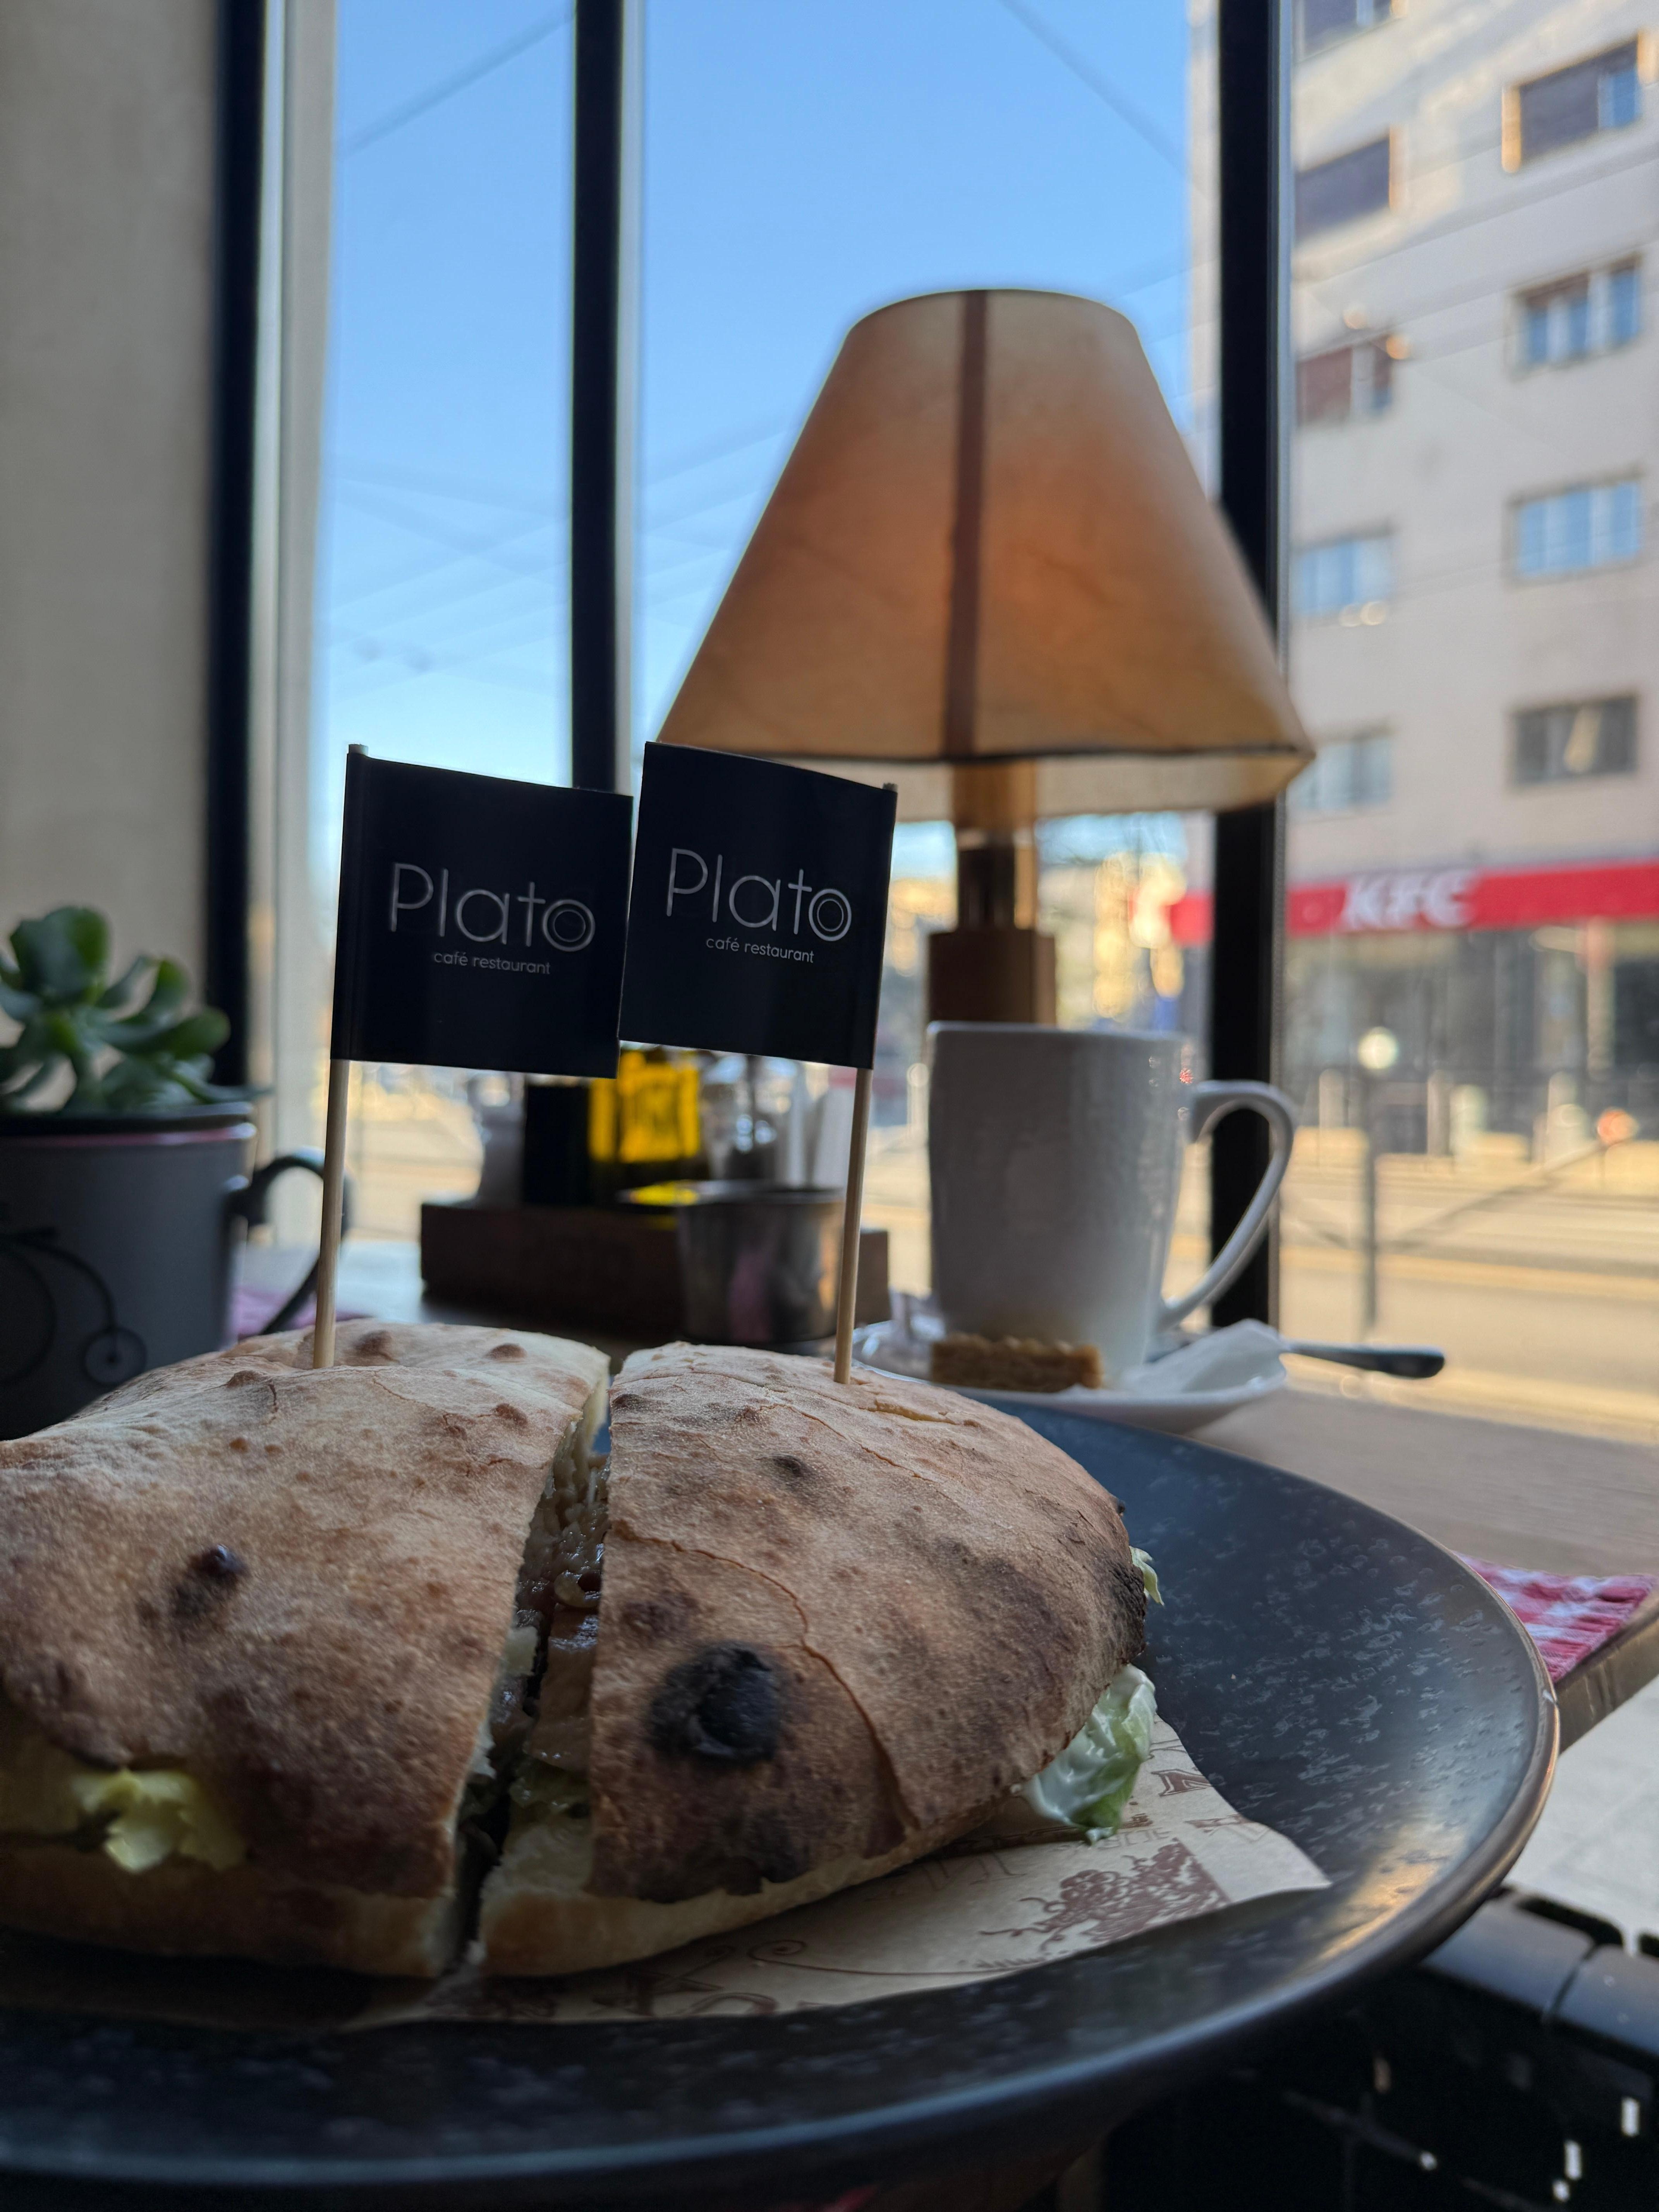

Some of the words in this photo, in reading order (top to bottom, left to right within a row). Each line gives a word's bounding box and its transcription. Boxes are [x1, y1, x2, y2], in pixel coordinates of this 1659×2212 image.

[391, 863, 595, 952] Plato
[666, 848, 852, 942] Plato
[1340, 871, 1475, 929] KFC
[433, 952, 468, 967] café
[472, 956, 551, 975] restaurant
[706, 937, 740, 952] café
[744, 943, 815, 963] restaurant
